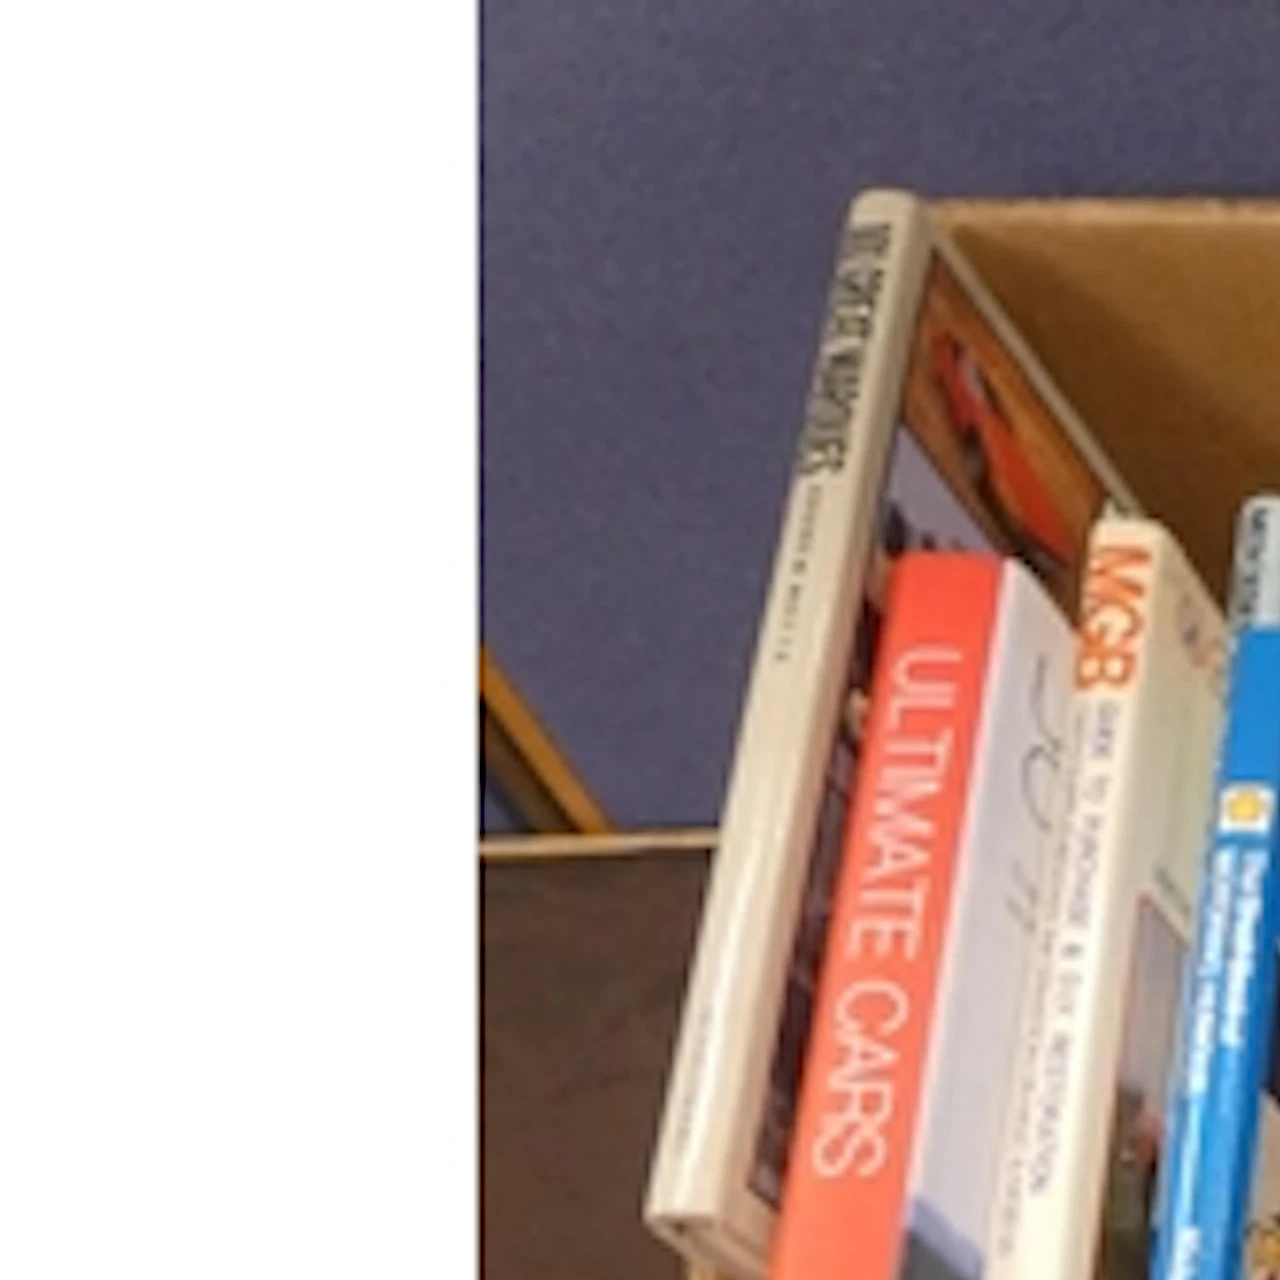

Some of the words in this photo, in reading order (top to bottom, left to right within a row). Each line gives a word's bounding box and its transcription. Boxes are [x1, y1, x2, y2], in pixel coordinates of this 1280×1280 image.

[1071, 543, 1153, 693] MGB
[847, 646, 966, 960] ULTIMATE
[807, 978, 914, 1180] CARS
